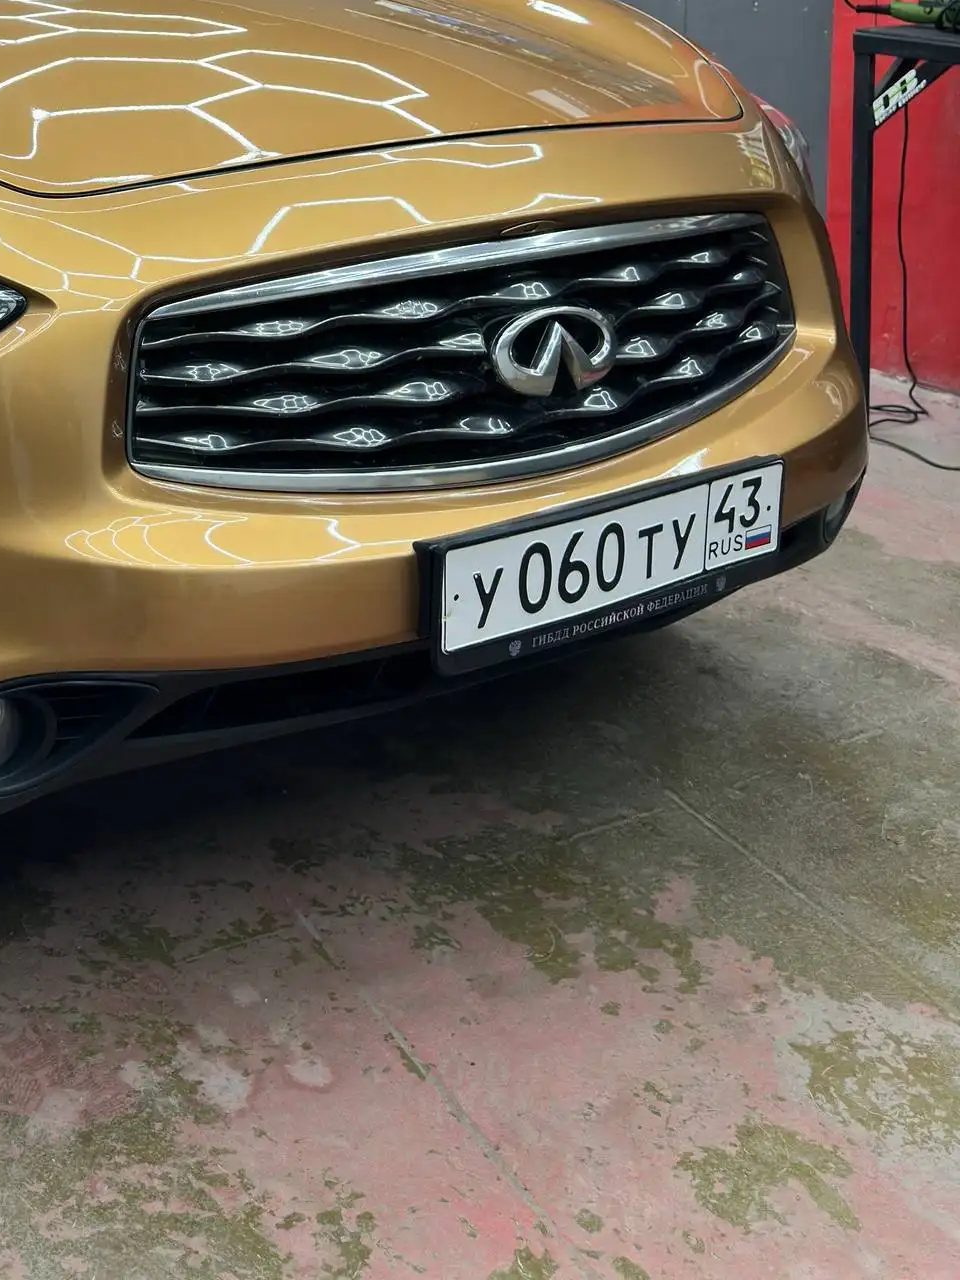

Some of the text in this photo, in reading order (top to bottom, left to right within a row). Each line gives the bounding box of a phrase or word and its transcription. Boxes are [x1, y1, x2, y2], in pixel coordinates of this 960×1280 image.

[714, 477, 762, 533] 43
[708, 534, 744, 560] RUS
[532, 583, 709, 648] ГИБДД РОССИЙСКОЙ ФЕДЕРАЦИИ
